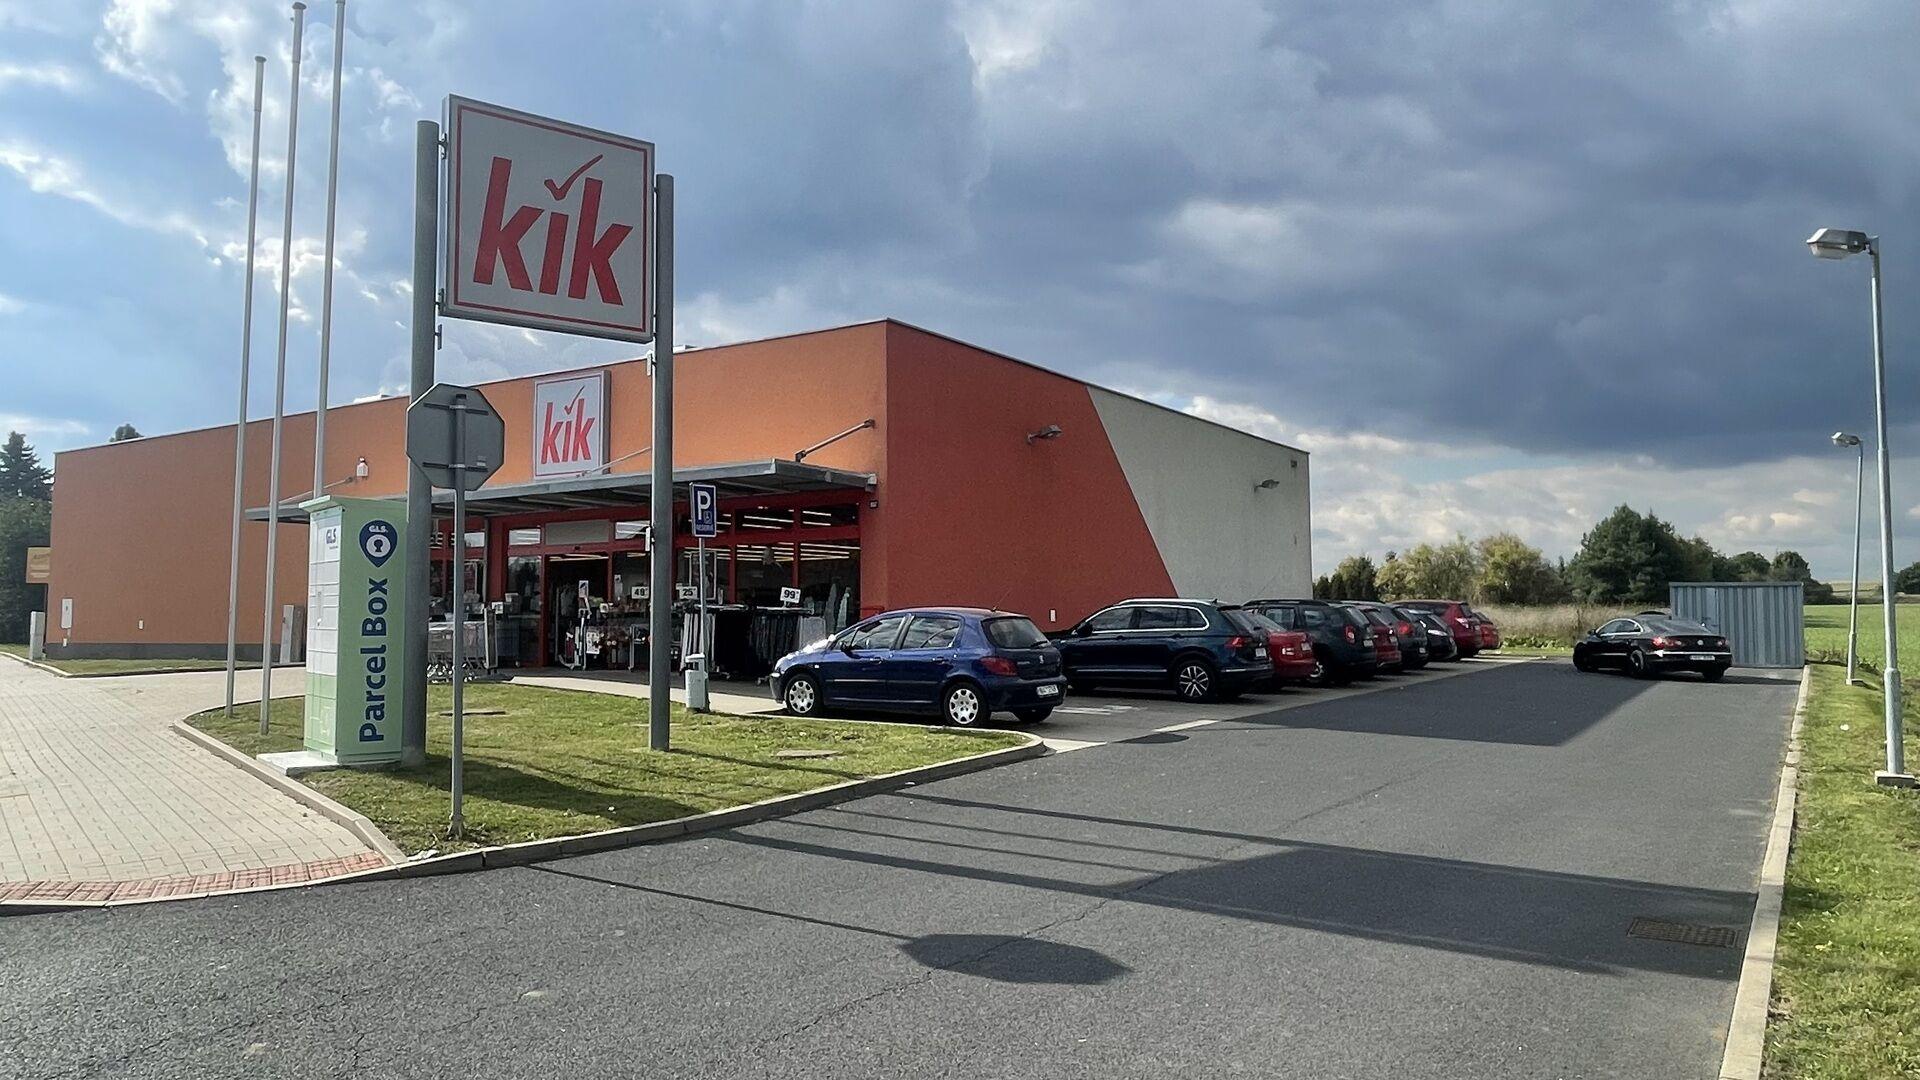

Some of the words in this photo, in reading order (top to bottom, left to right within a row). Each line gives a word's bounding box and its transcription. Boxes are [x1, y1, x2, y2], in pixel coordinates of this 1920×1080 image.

[473, 155, 633, 306] kik
[541, 385, 595, 464] kik
[697, 490, 711, 520] P
[361, 578, 388, 636] Box
[359, 644, 387, 742] Parcel
